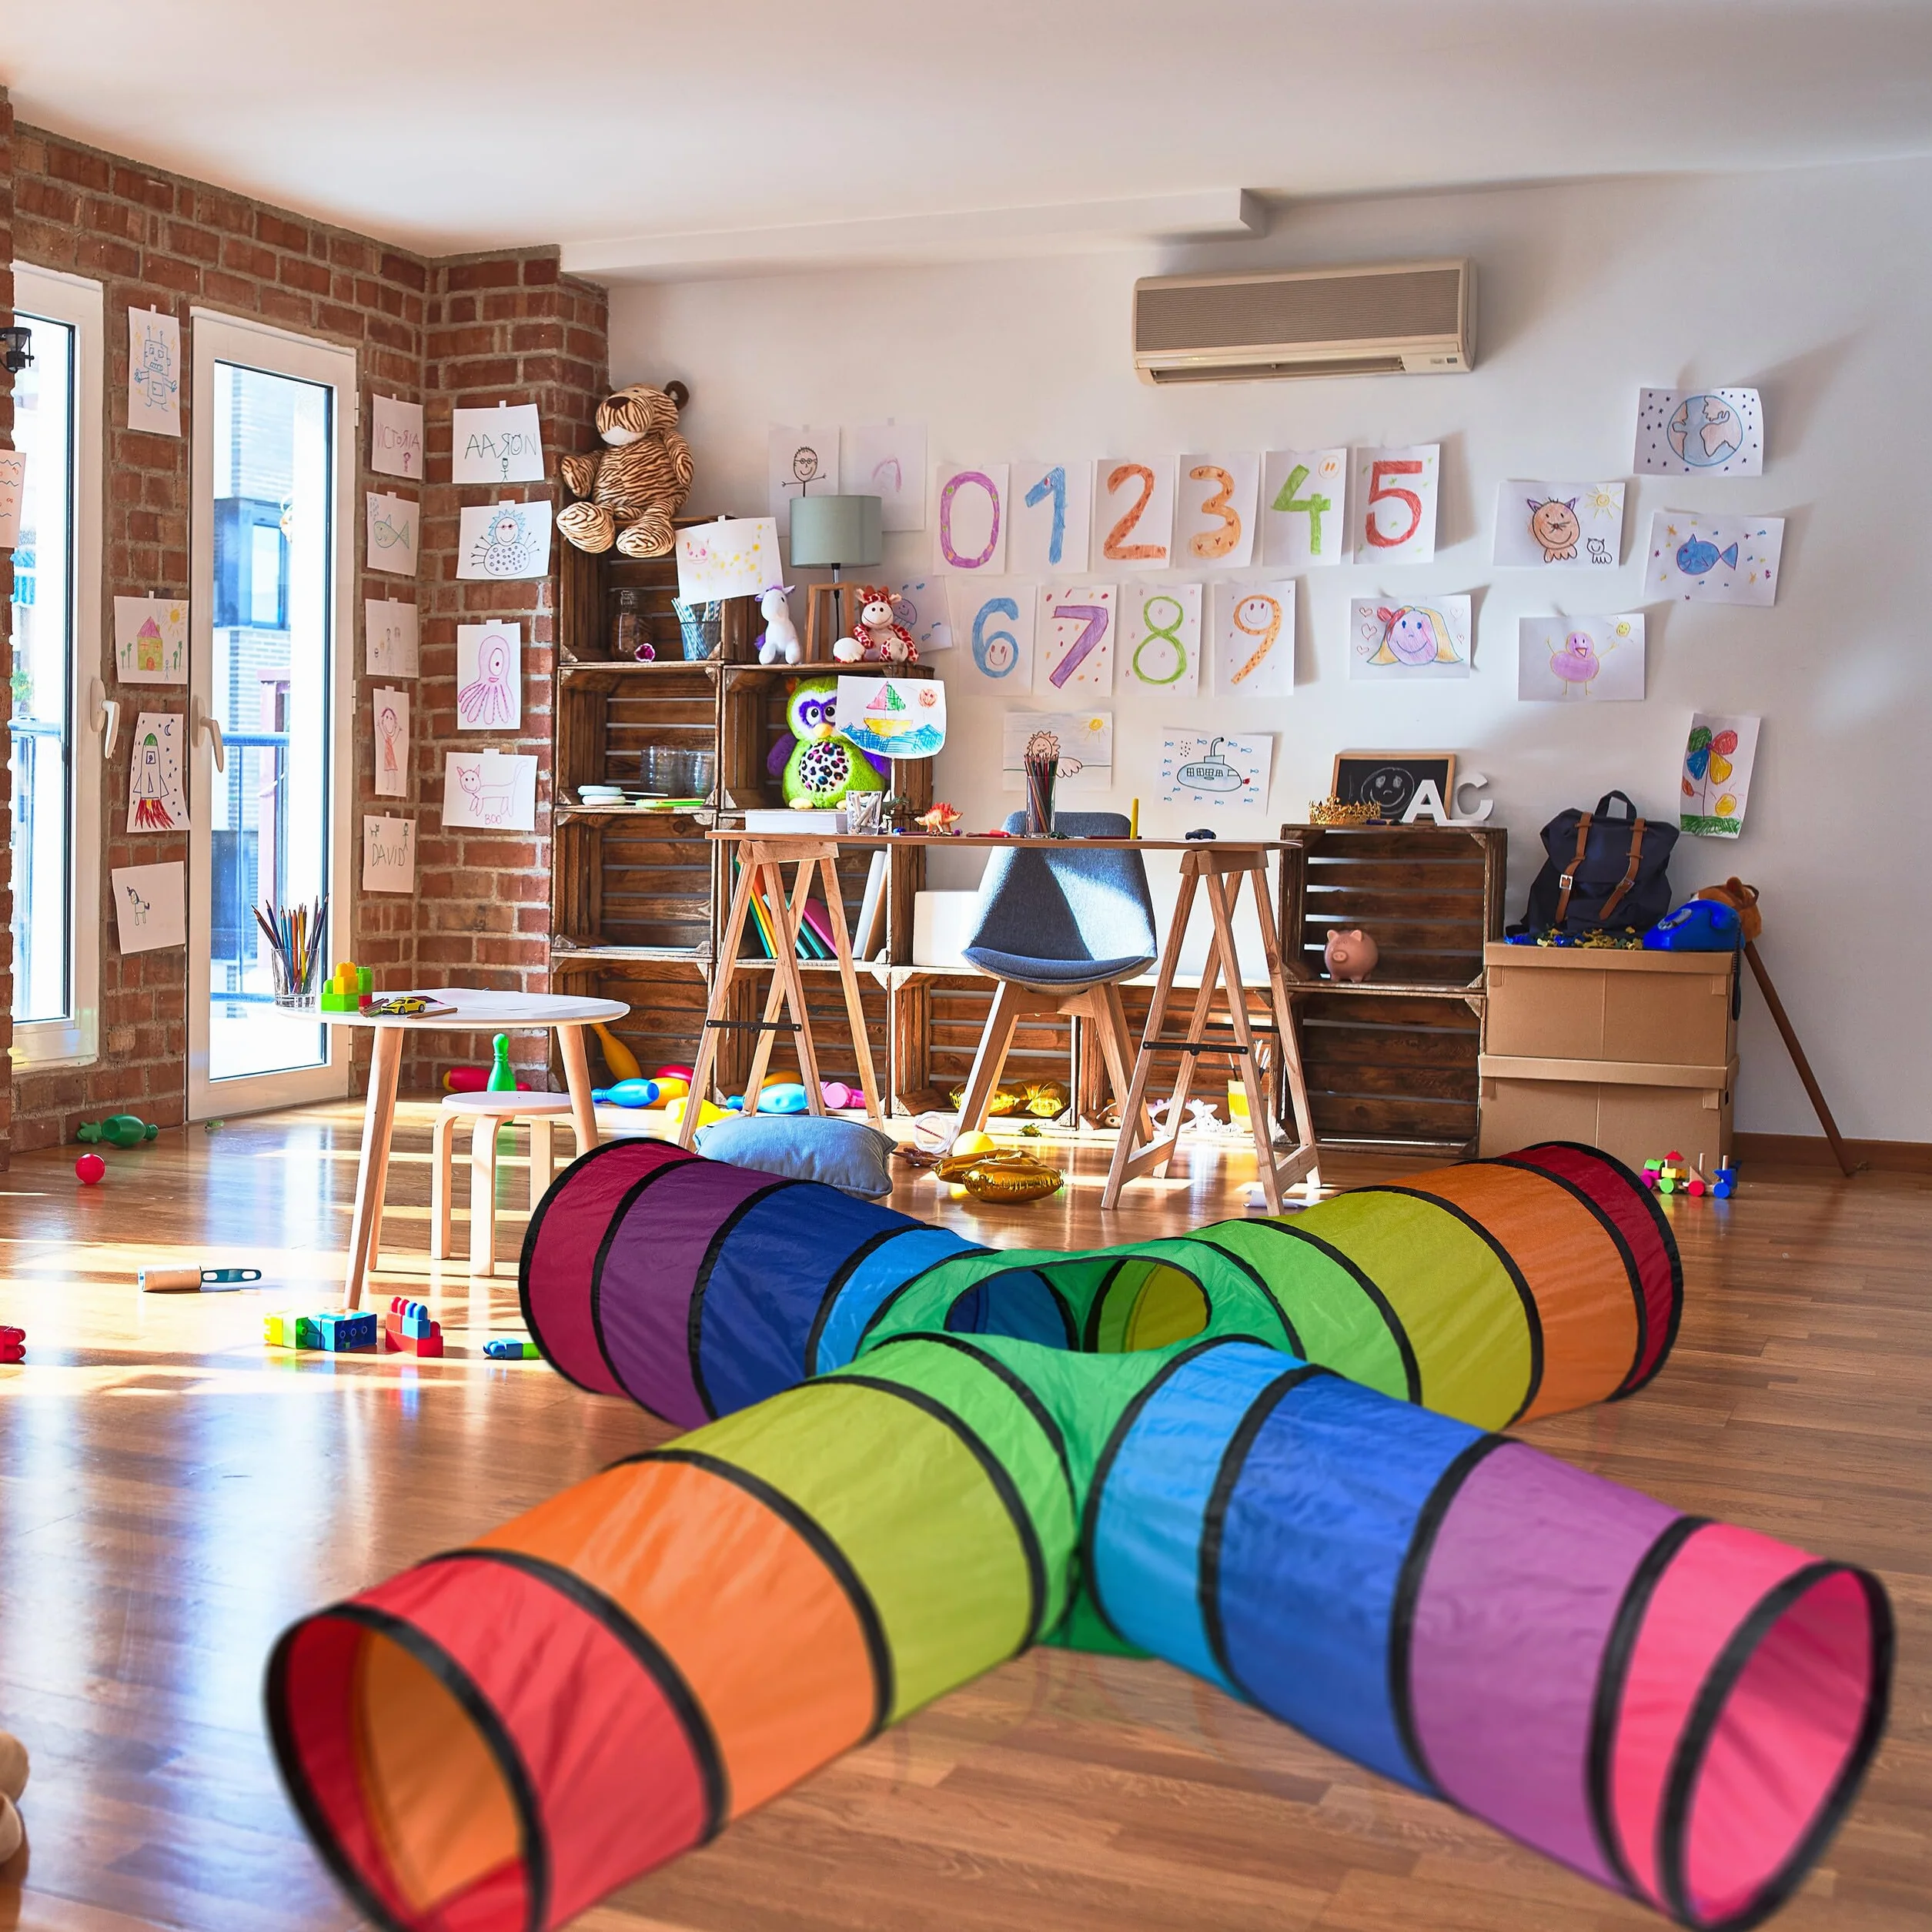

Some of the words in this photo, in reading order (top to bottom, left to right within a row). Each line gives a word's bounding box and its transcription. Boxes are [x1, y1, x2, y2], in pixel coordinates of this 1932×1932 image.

[375, 423, 421, 451] VICTORIA
[464, 433, 537, 460] AARON
[941, 471, 1000, 568] 0
[1024, 466, 1066, 566] 1
[1104, 463, 1166, 560] 2
[1188, 465, 1242, 560] 3
[1271, 463, 1331, 555] 4
[1365, 460, 1422, 547] 5
[971, 597, 1019, 678] 6
[1051, 605, 1108, 689] 7
[1132, 596, 1187, 684] 8
[1232, 594, 1283, 684] 9
[372, 844, 406, 867] DAVID
[484, 814, 502, 825] BOO
